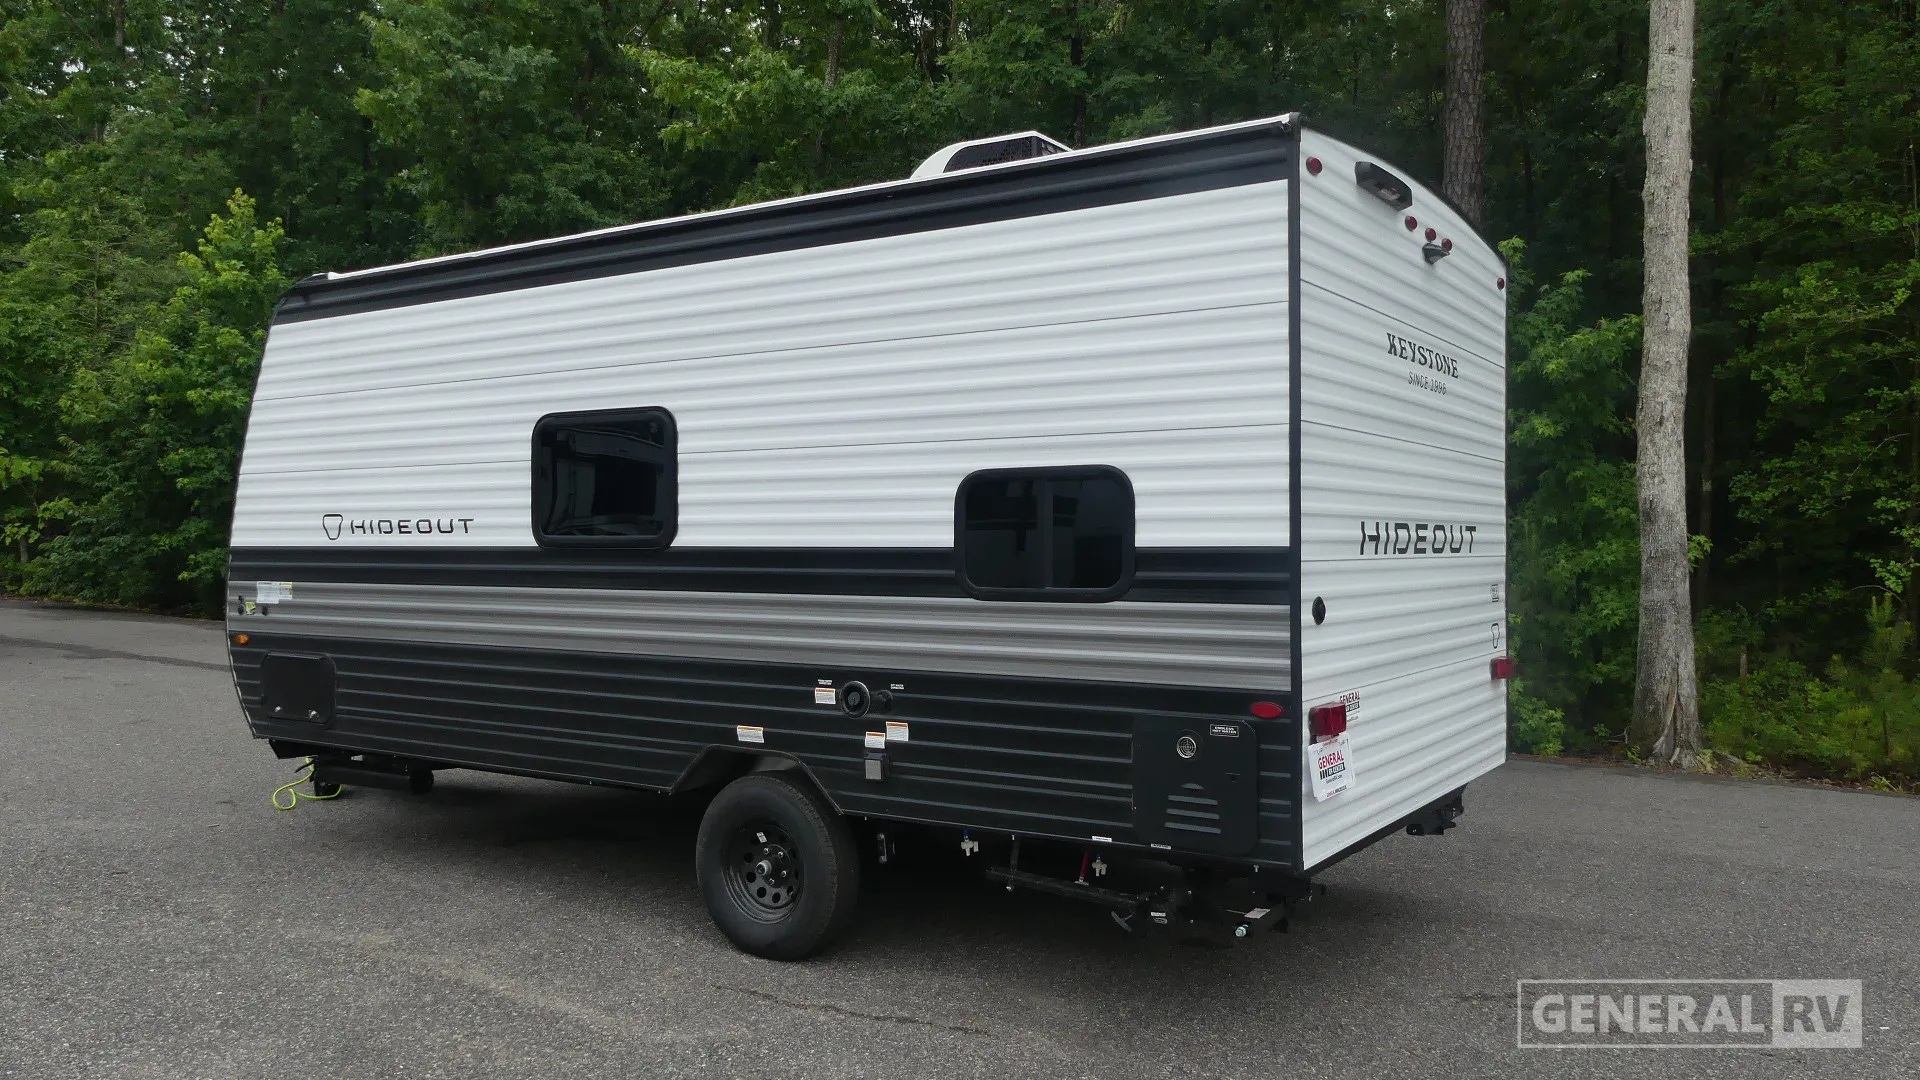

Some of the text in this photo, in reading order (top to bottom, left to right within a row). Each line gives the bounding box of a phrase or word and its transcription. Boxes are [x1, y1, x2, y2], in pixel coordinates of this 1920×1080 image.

[1387, 332, 1459, 379] KEYSTONE
[1408, 370, 1447, 396] SINCE 1996
[350, 518, 475, 535] HIDEOUT
[1360, 521, 1477, 556] HIDEOUT
[1318, 750, 1344, 769] GENERAL
